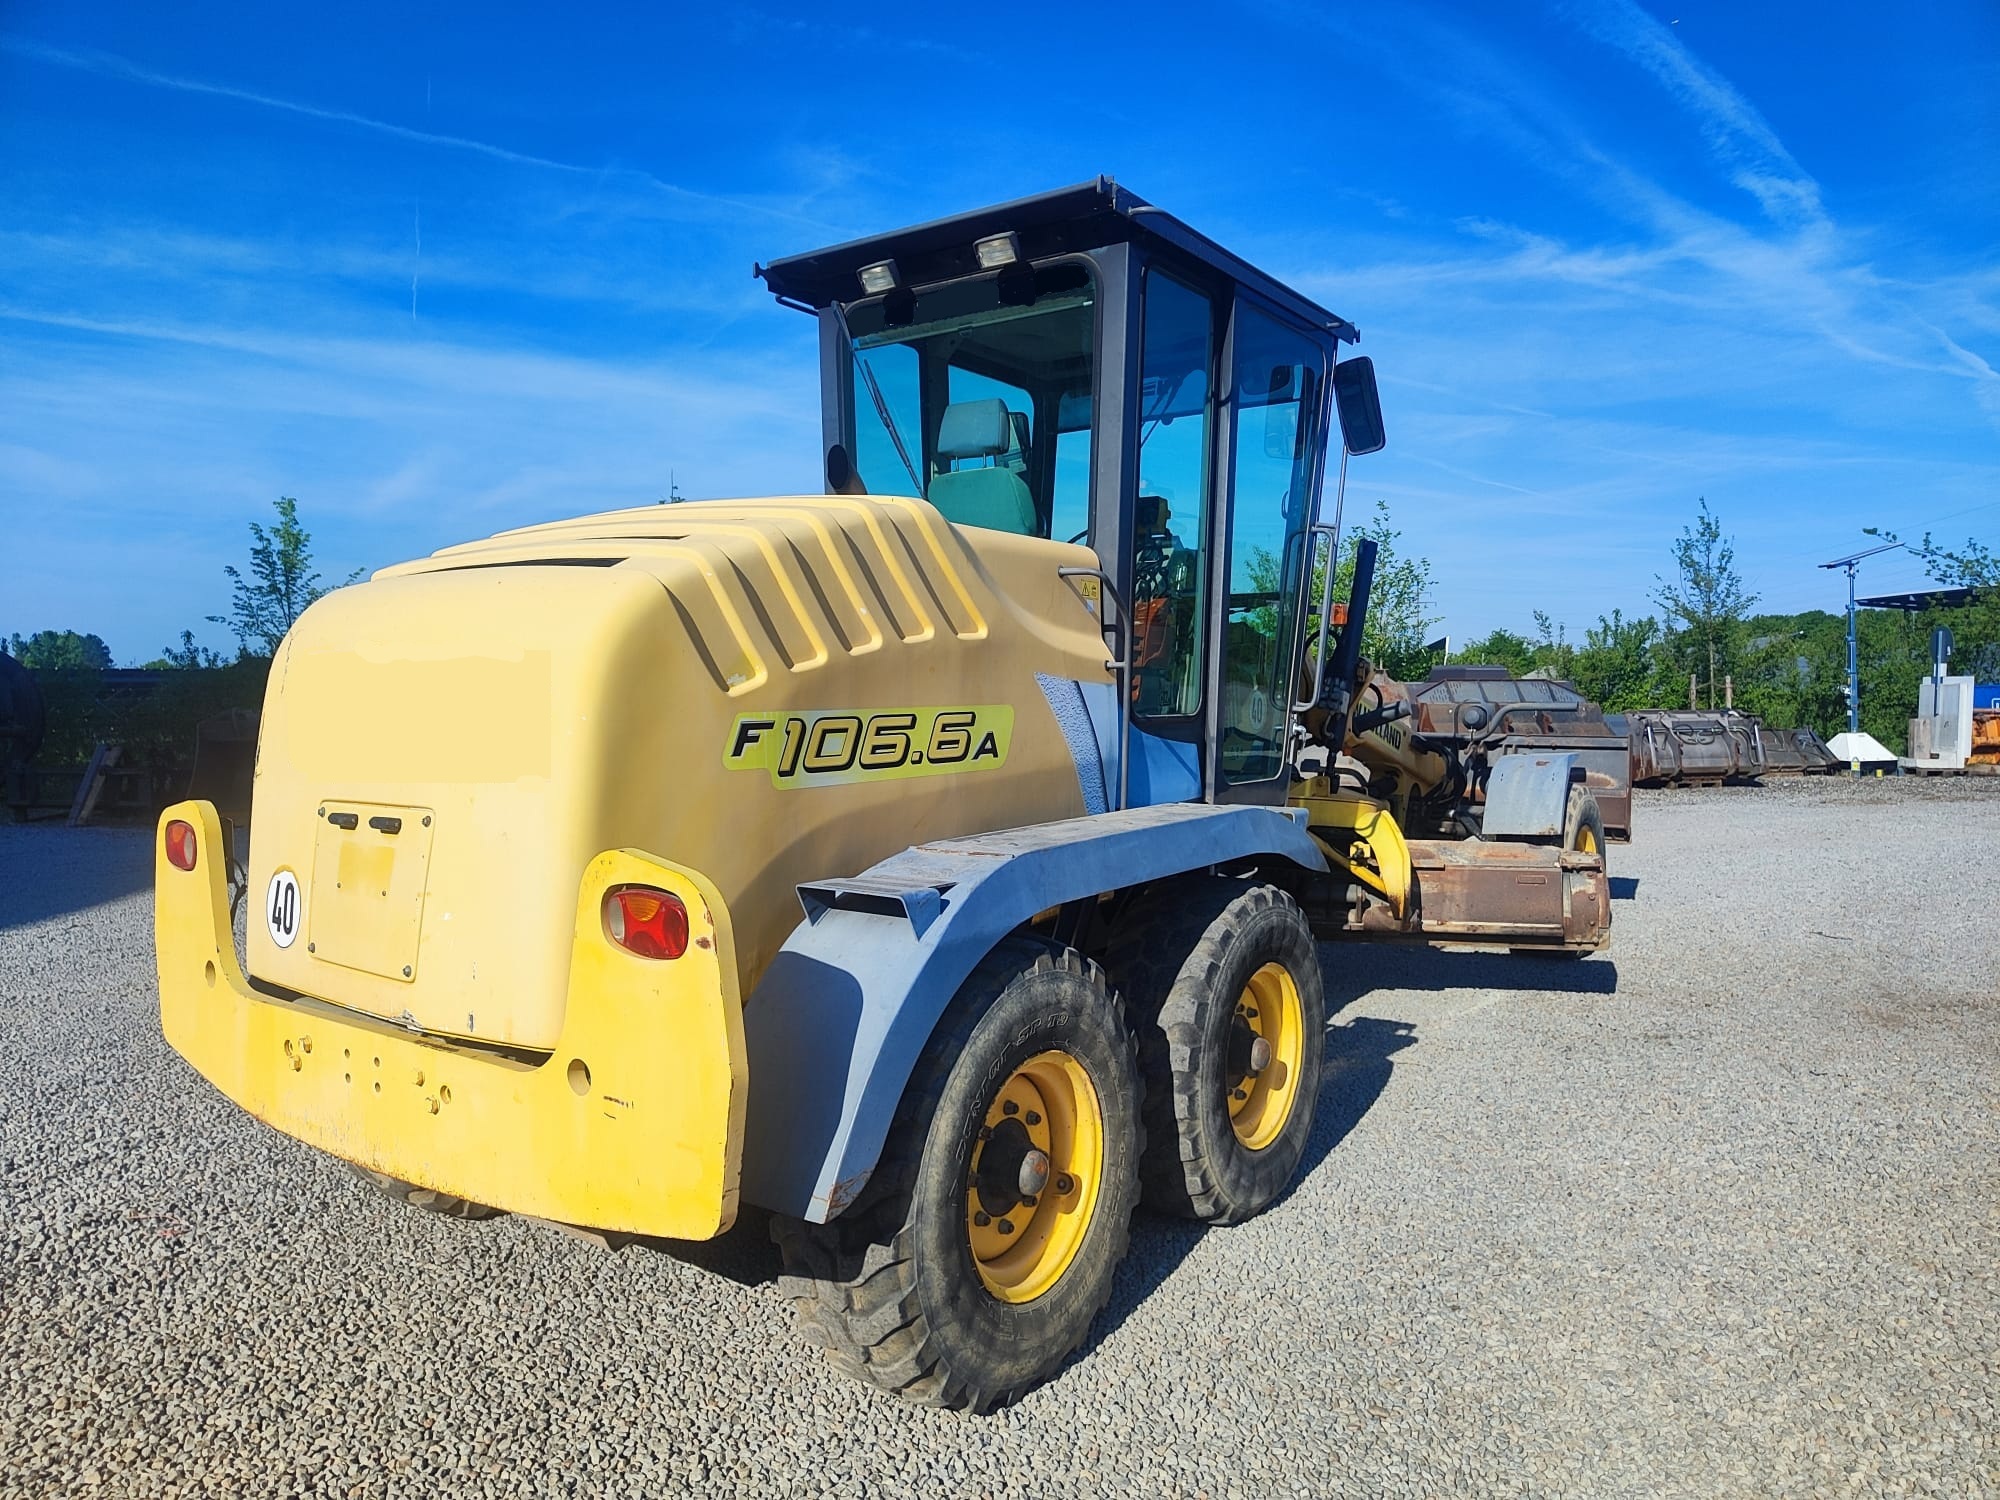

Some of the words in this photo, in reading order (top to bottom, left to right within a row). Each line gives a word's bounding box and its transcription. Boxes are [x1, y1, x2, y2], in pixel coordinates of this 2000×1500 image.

[1252, 695, 1262, 722] 40
[272, 879, 295, 936] 40
[1015, 1018, 1042, 1047] SP
